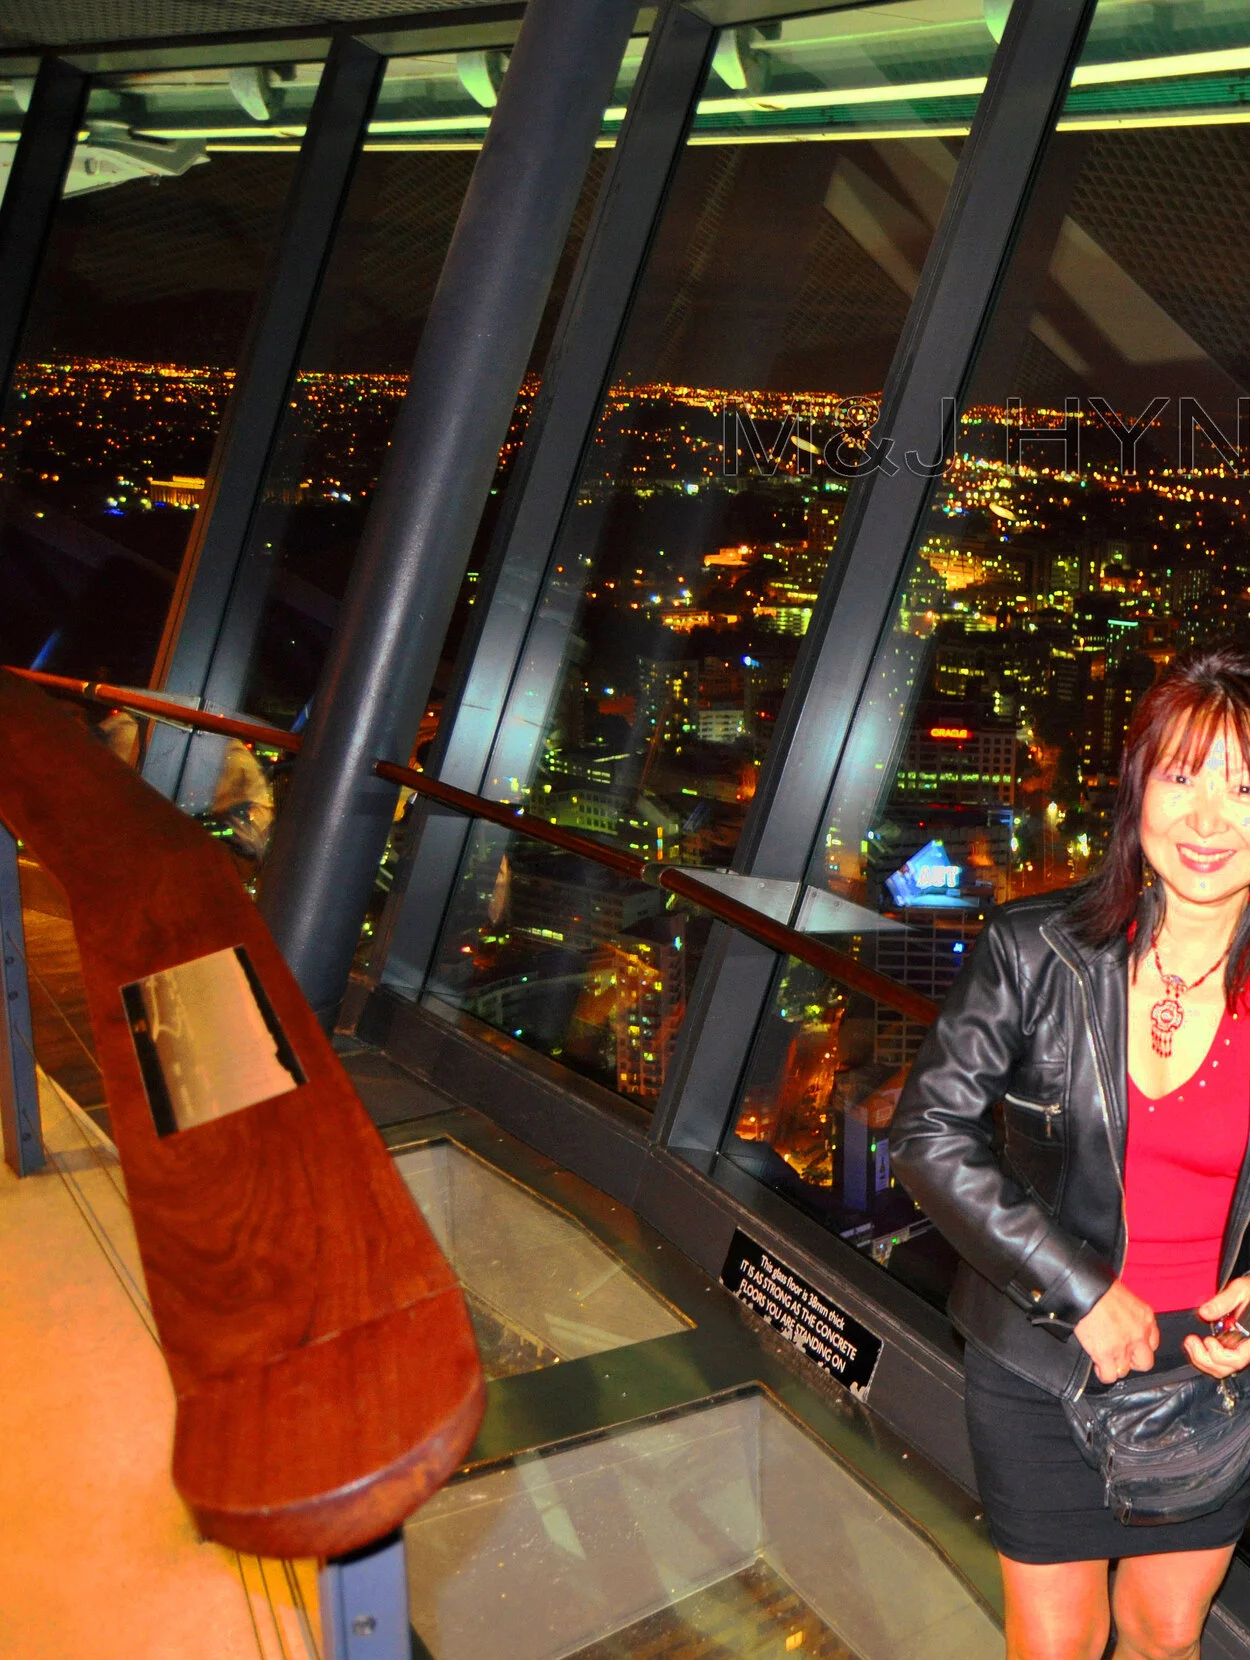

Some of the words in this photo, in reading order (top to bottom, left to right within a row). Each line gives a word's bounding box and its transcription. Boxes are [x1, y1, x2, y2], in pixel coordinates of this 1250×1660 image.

[930, 727, 968, 739] ORACLE
[739, 1278, 767, 1307] FLOORS
[766, 1298, 783, 1320] YOU
[780, 1313, 796, 1330] ARE
[794, 1323, 833, 1362] STANDING
[831, 1354, 847, 1374] ON
[740, 1259, 749, 1272] IT
[747, 1265, 756, 1278] IS
[753, 1271, 764, 1285] AS
[762, 1277, 792, 1308] STRONG
[790, 1301, 802, 1315] AS
[801, 1308, 817, 1329] THE
[815, 1320, 858, 1361] CONCRETE
[761, 1254, 774, 1273] This
[771, 1267, 788, 1285] glass
[787, 1276, 803, 1296] floor
[802, 1289, 809, 1301] is
[828, 1310, 845, 1331] thick
